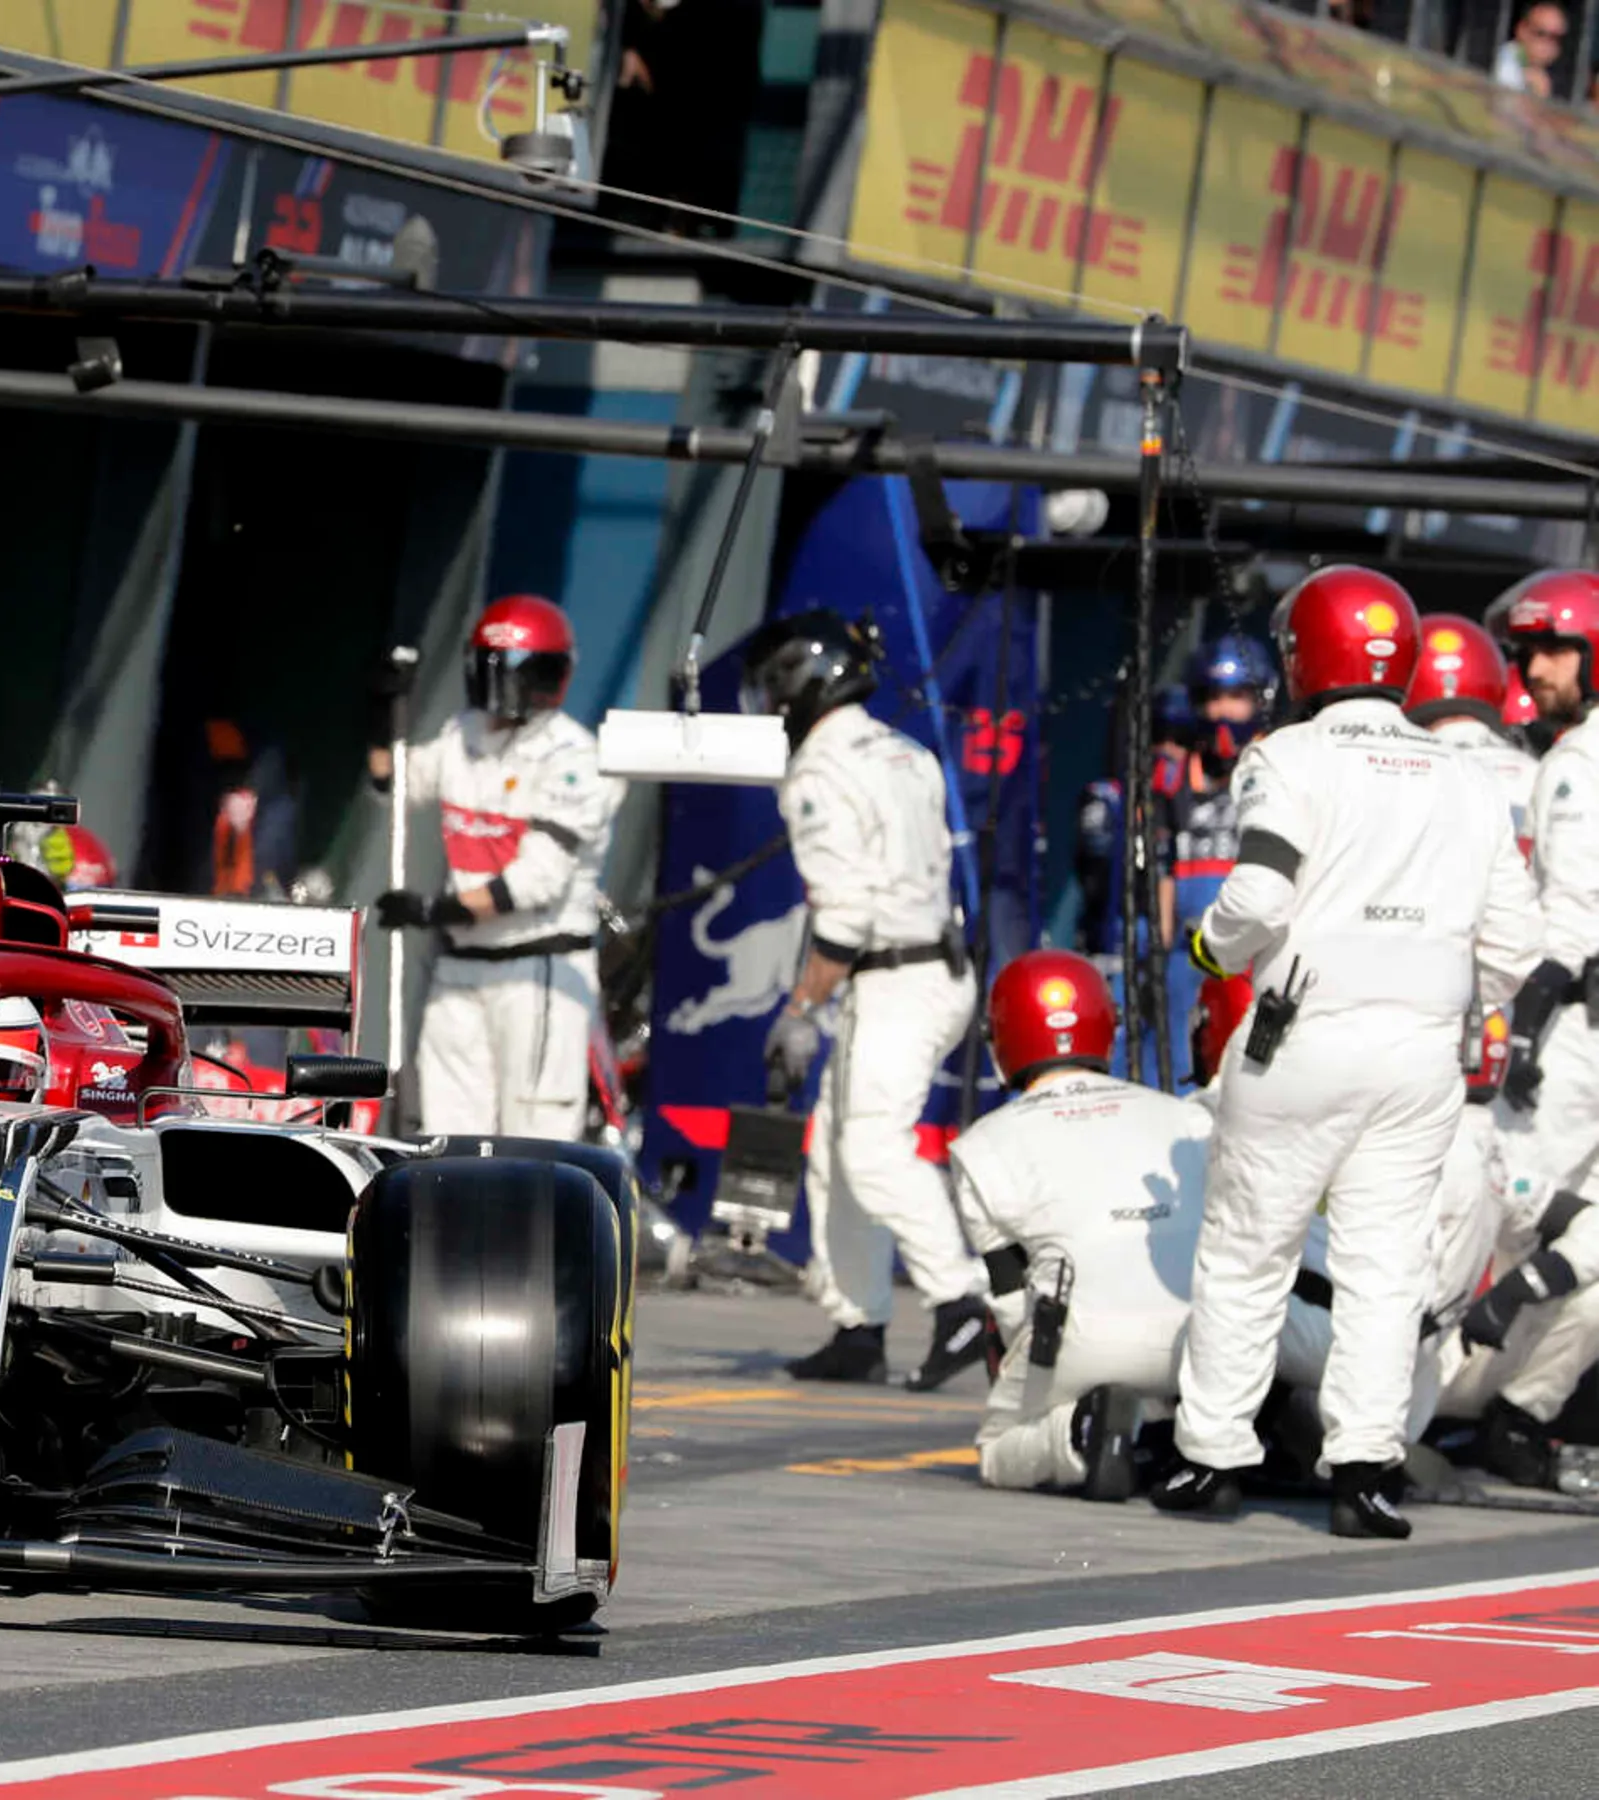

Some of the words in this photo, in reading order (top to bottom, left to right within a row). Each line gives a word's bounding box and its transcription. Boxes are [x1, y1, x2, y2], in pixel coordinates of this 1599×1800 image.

[173, 899, 337, 958] Svizzera
[80, 1088, 136, 1103] SINGHA
[410, 1718, 1016, 1791] STR
